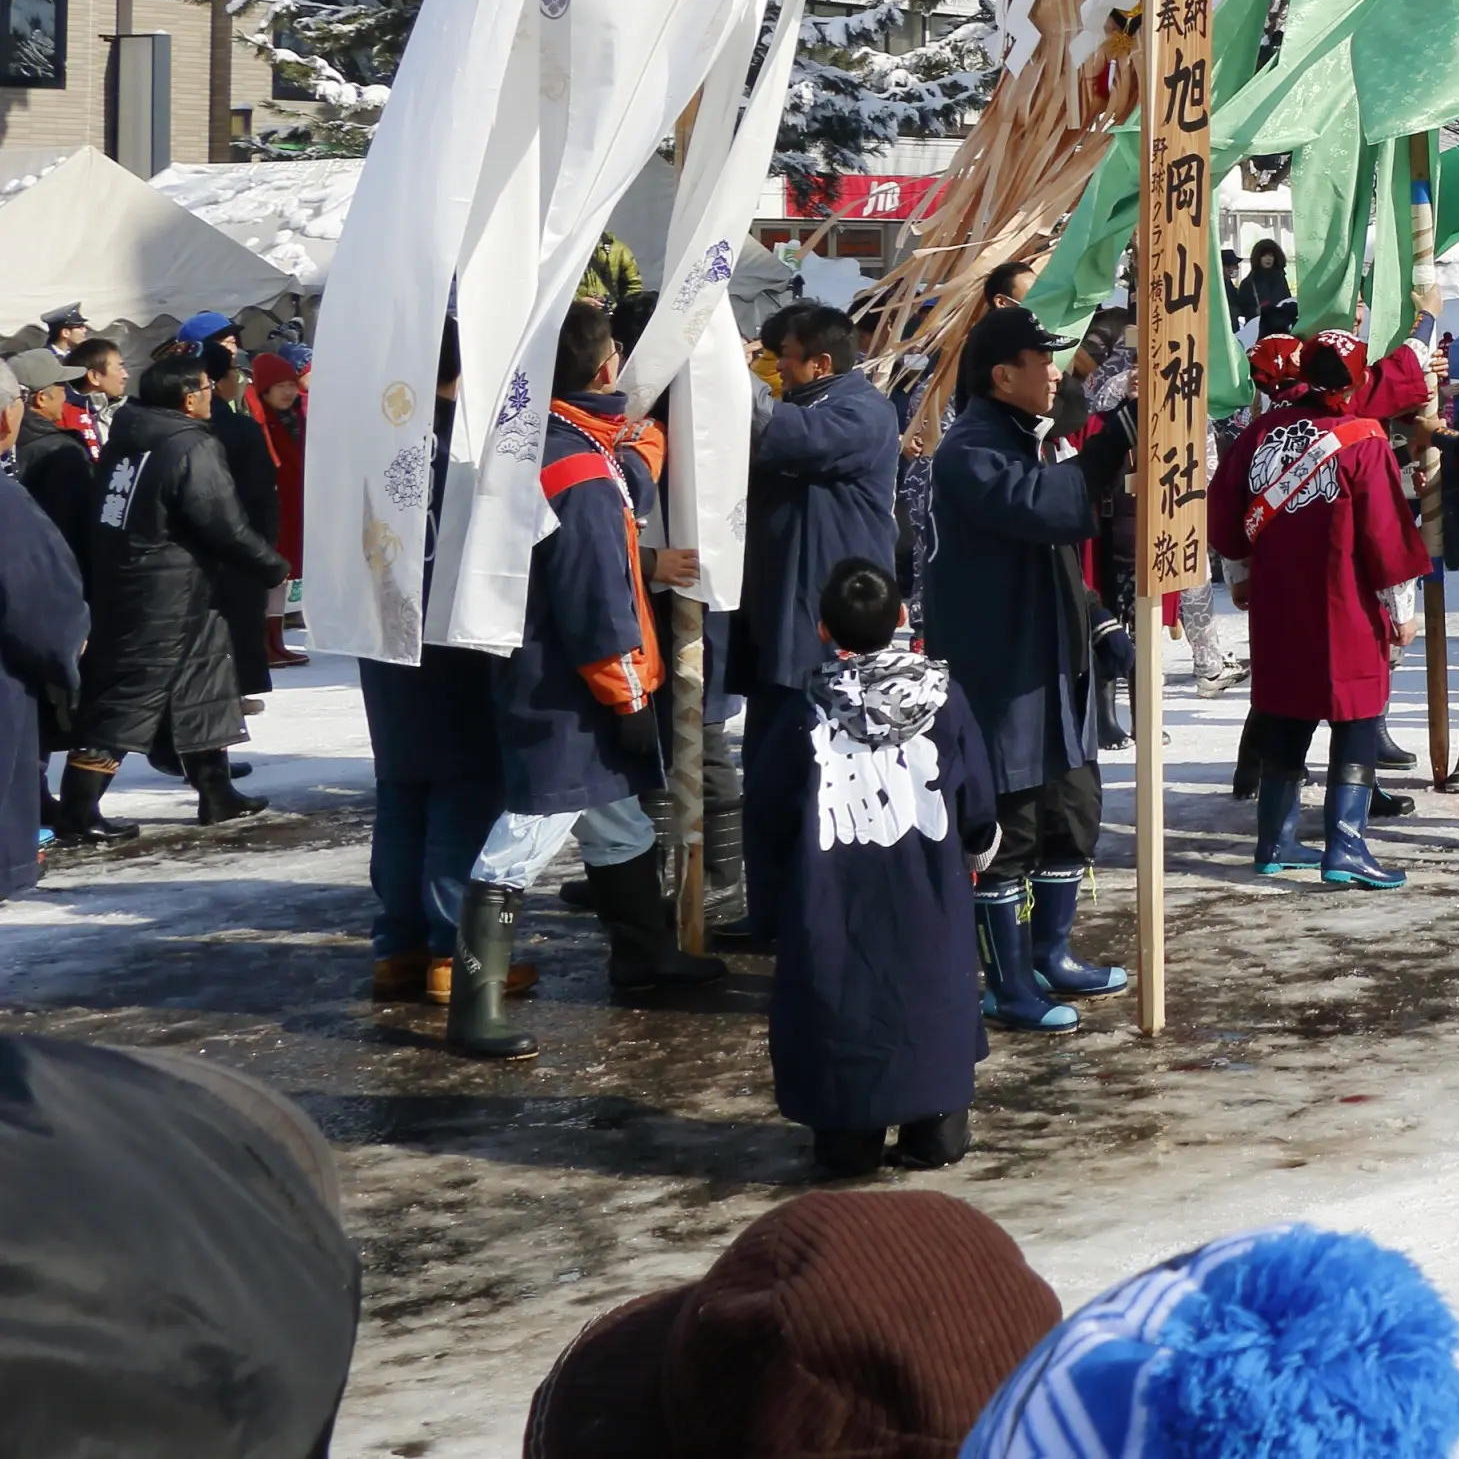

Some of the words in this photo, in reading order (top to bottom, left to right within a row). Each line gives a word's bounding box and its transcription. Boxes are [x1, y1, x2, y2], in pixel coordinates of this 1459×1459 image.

[1147, 137, 1168, 464] 野球クラブ横手シャークス
[1159, 47, 1209, 520] 旭岡山神社
[1150, 524, 1200, 584] 敬白
